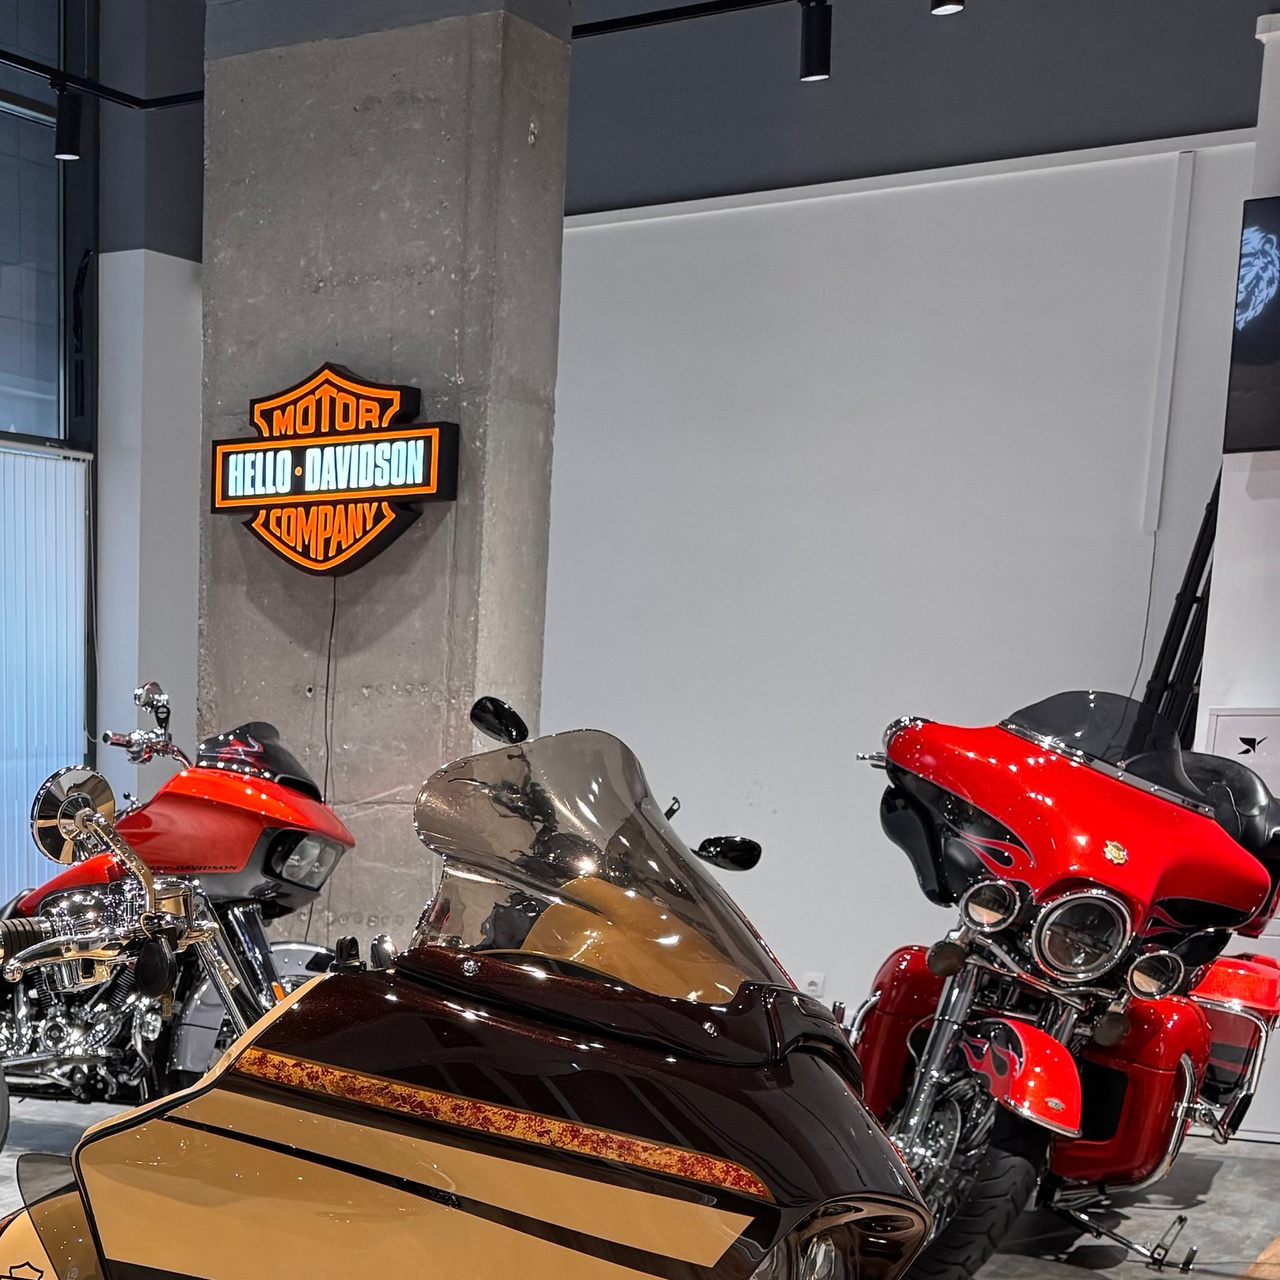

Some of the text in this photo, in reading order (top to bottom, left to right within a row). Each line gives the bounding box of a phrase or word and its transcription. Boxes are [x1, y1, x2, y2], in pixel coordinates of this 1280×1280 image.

[273, 383, 379, 436] MOTOR
[228, 440, 424, 496] HELLO DAVIDSON
[270, 502, 378, 560] COMPANY
